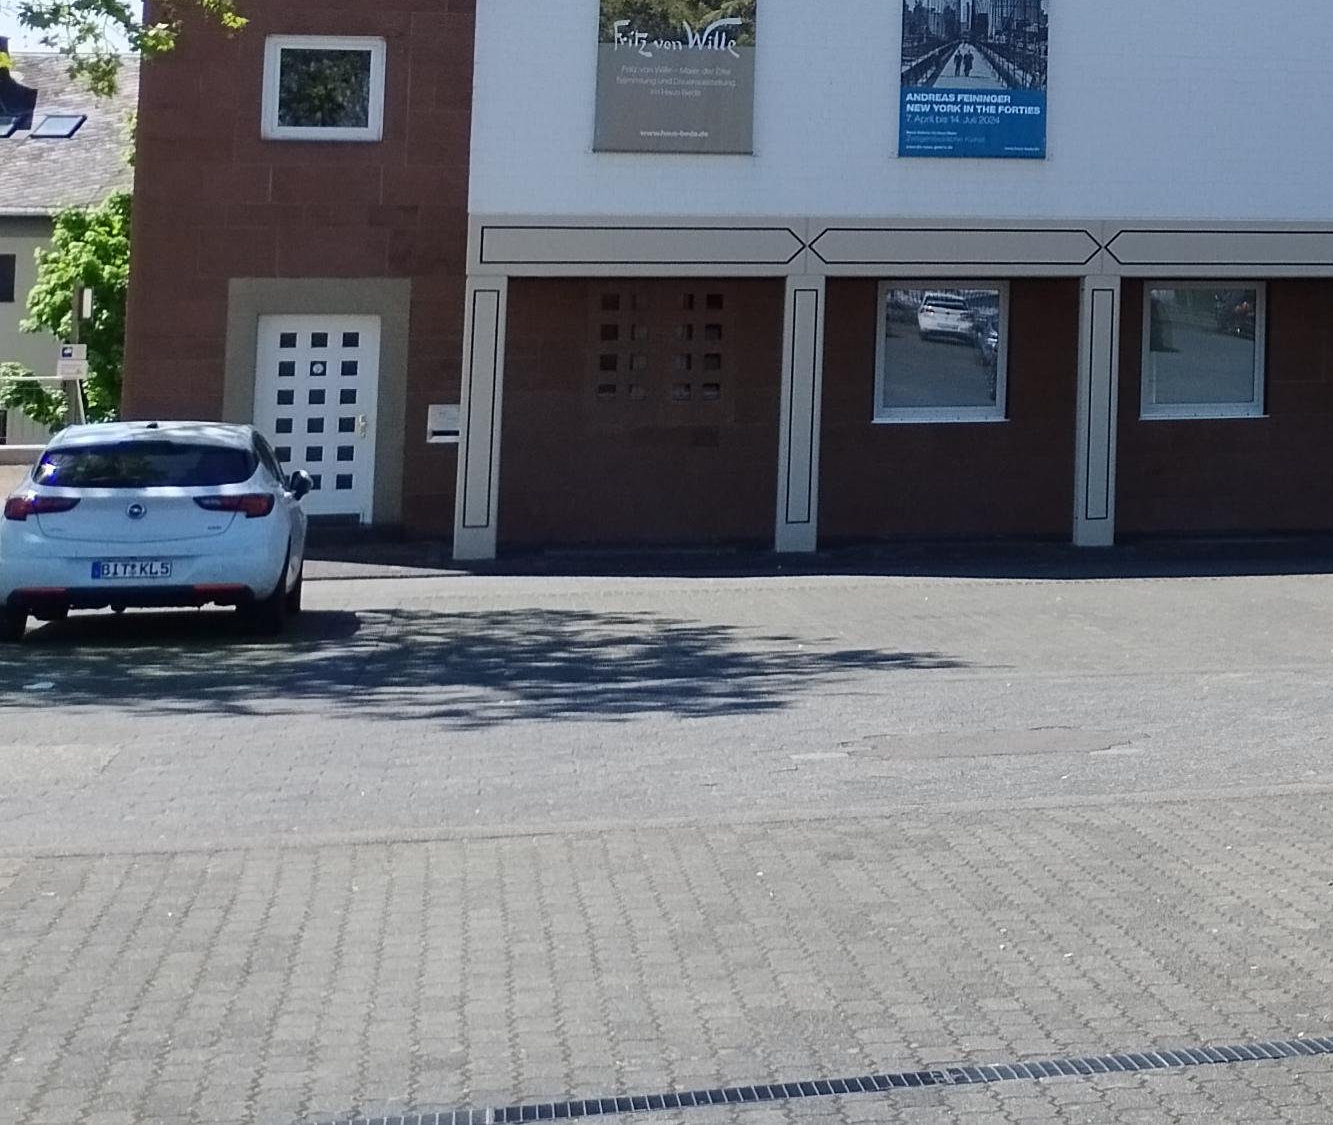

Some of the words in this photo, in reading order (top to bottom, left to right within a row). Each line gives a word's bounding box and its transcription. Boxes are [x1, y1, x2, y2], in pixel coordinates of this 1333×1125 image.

[614, 19, 653, 57] Fritz
[654, 40, 682, 51] von
[683, 17, 743, 58] Wille
[906, 93, 954, 102] ANDREAS
[957, 94, 1011, 103] FEININGER
[906, 104, 931, 112] NEW
[933, 104, 961, 113] YORK
[963, 105, 974, 113] IN
[975, 105, 996, 114] THE
[998, 106, 1041, 115] FORTIES
[914, 115, 935, 125] April
